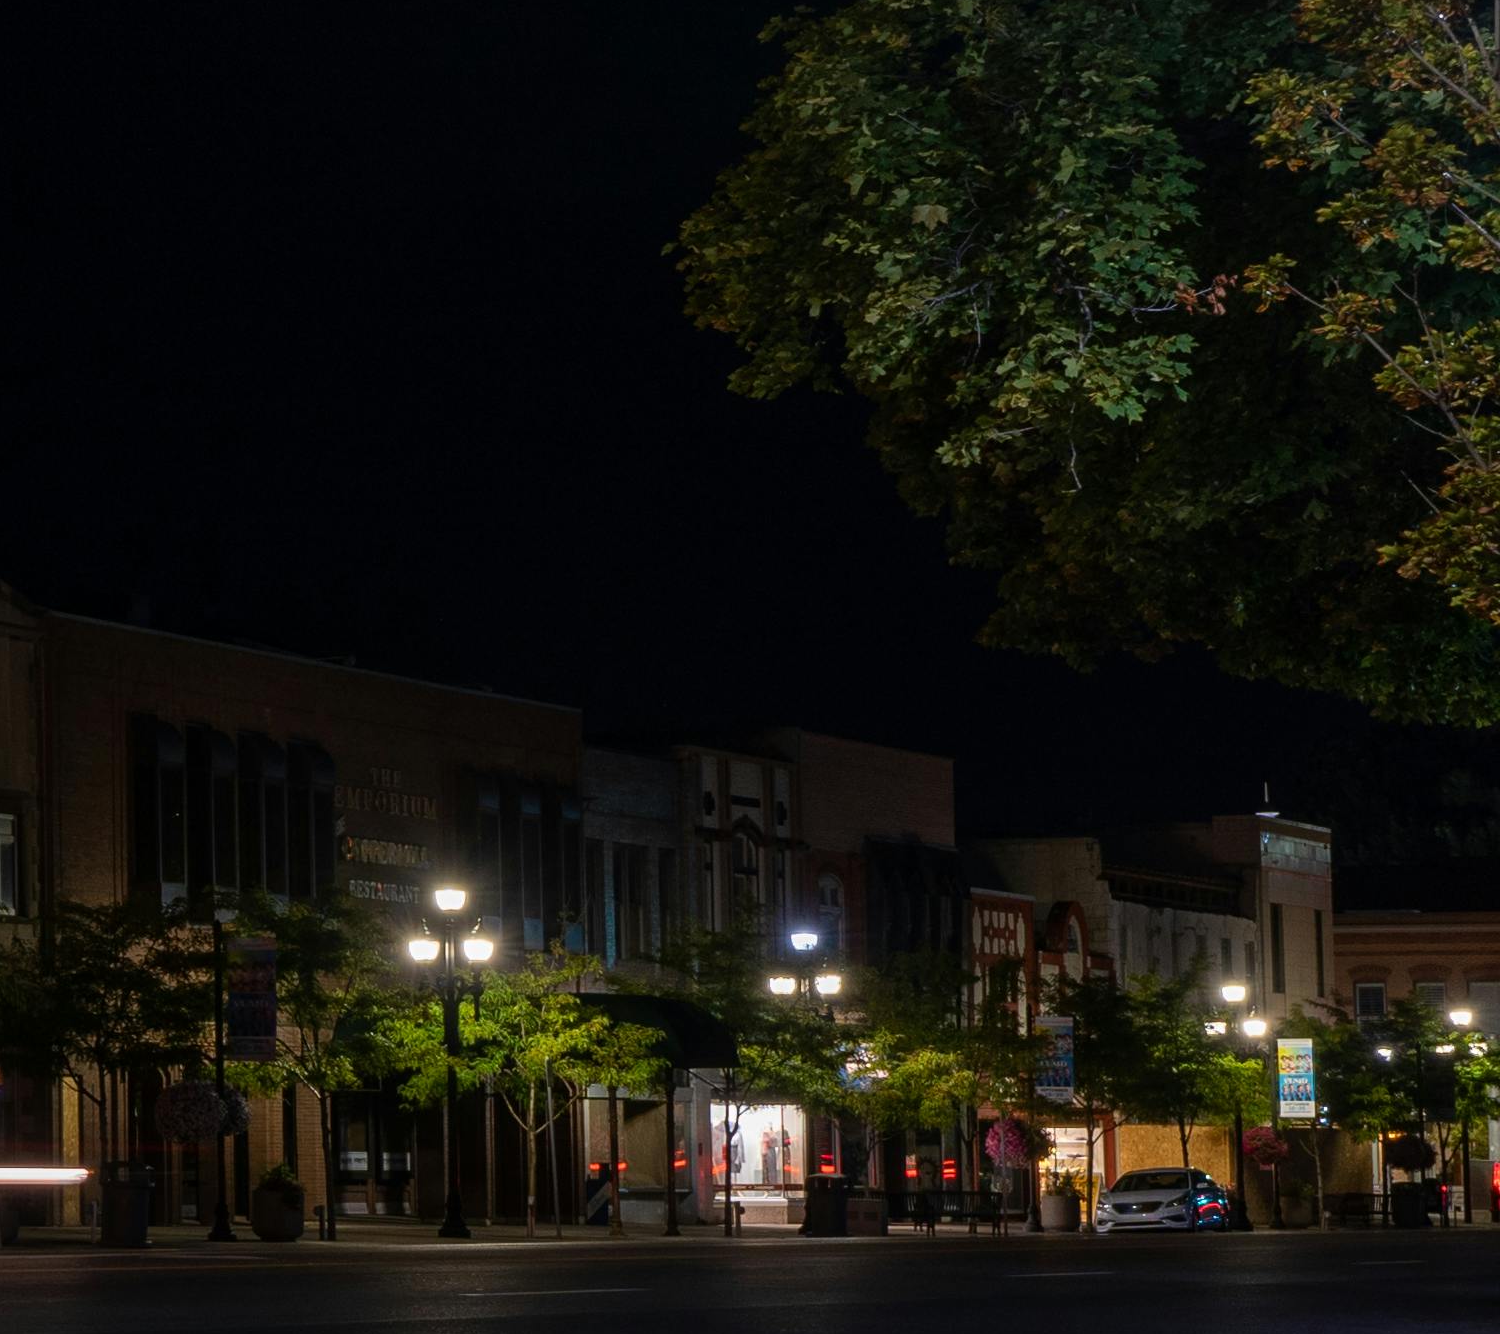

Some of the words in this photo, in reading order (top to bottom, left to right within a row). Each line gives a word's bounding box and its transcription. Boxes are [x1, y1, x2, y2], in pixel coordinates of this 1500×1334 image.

[370, 767, 402, 788] THE
[334, 784, 437, 819] EMPORIUM
[349, 880, 421, 904] RESTAURANT
